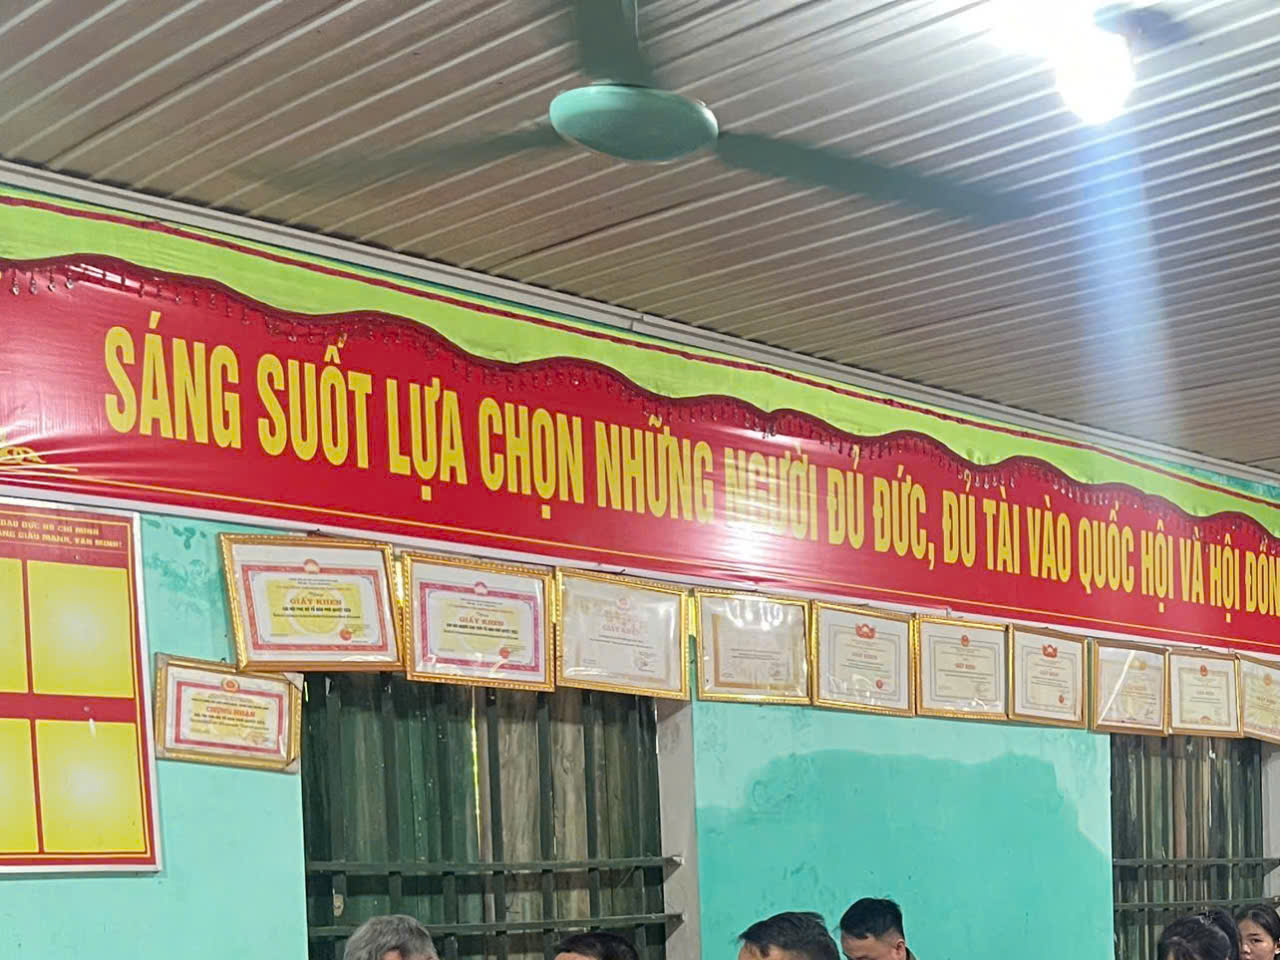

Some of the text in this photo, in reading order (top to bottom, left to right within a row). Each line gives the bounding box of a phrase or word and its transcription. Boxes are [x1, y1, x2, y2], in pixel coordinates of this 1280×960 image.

[104, 311, 241, 449] SÁNG
[257, 332, 372, 469] SUỐT
[387, 377, 469, 500] LỰA
[478, 397, 585, 519] CHỌN
[594, 414, 715, 525] NHỮNG
[724, 442, 819, 542] NGƯỜI
[827, 445, 864, 549] ĐỦ
[873, 465, 935, 570] ĐỨC,
[942, 468, 976, 567] ĐỦ
[983, 486, 1020, 574] TÀI
[1027, 495, 1071, 583] VÀO
[1078, 500, 1135, 594] QUỐC
[1141, 519, 1174, 613] HỘI
[1178, 527, 1204, 604] VÀ
[1209, 534, 1240, 623] HỘI
